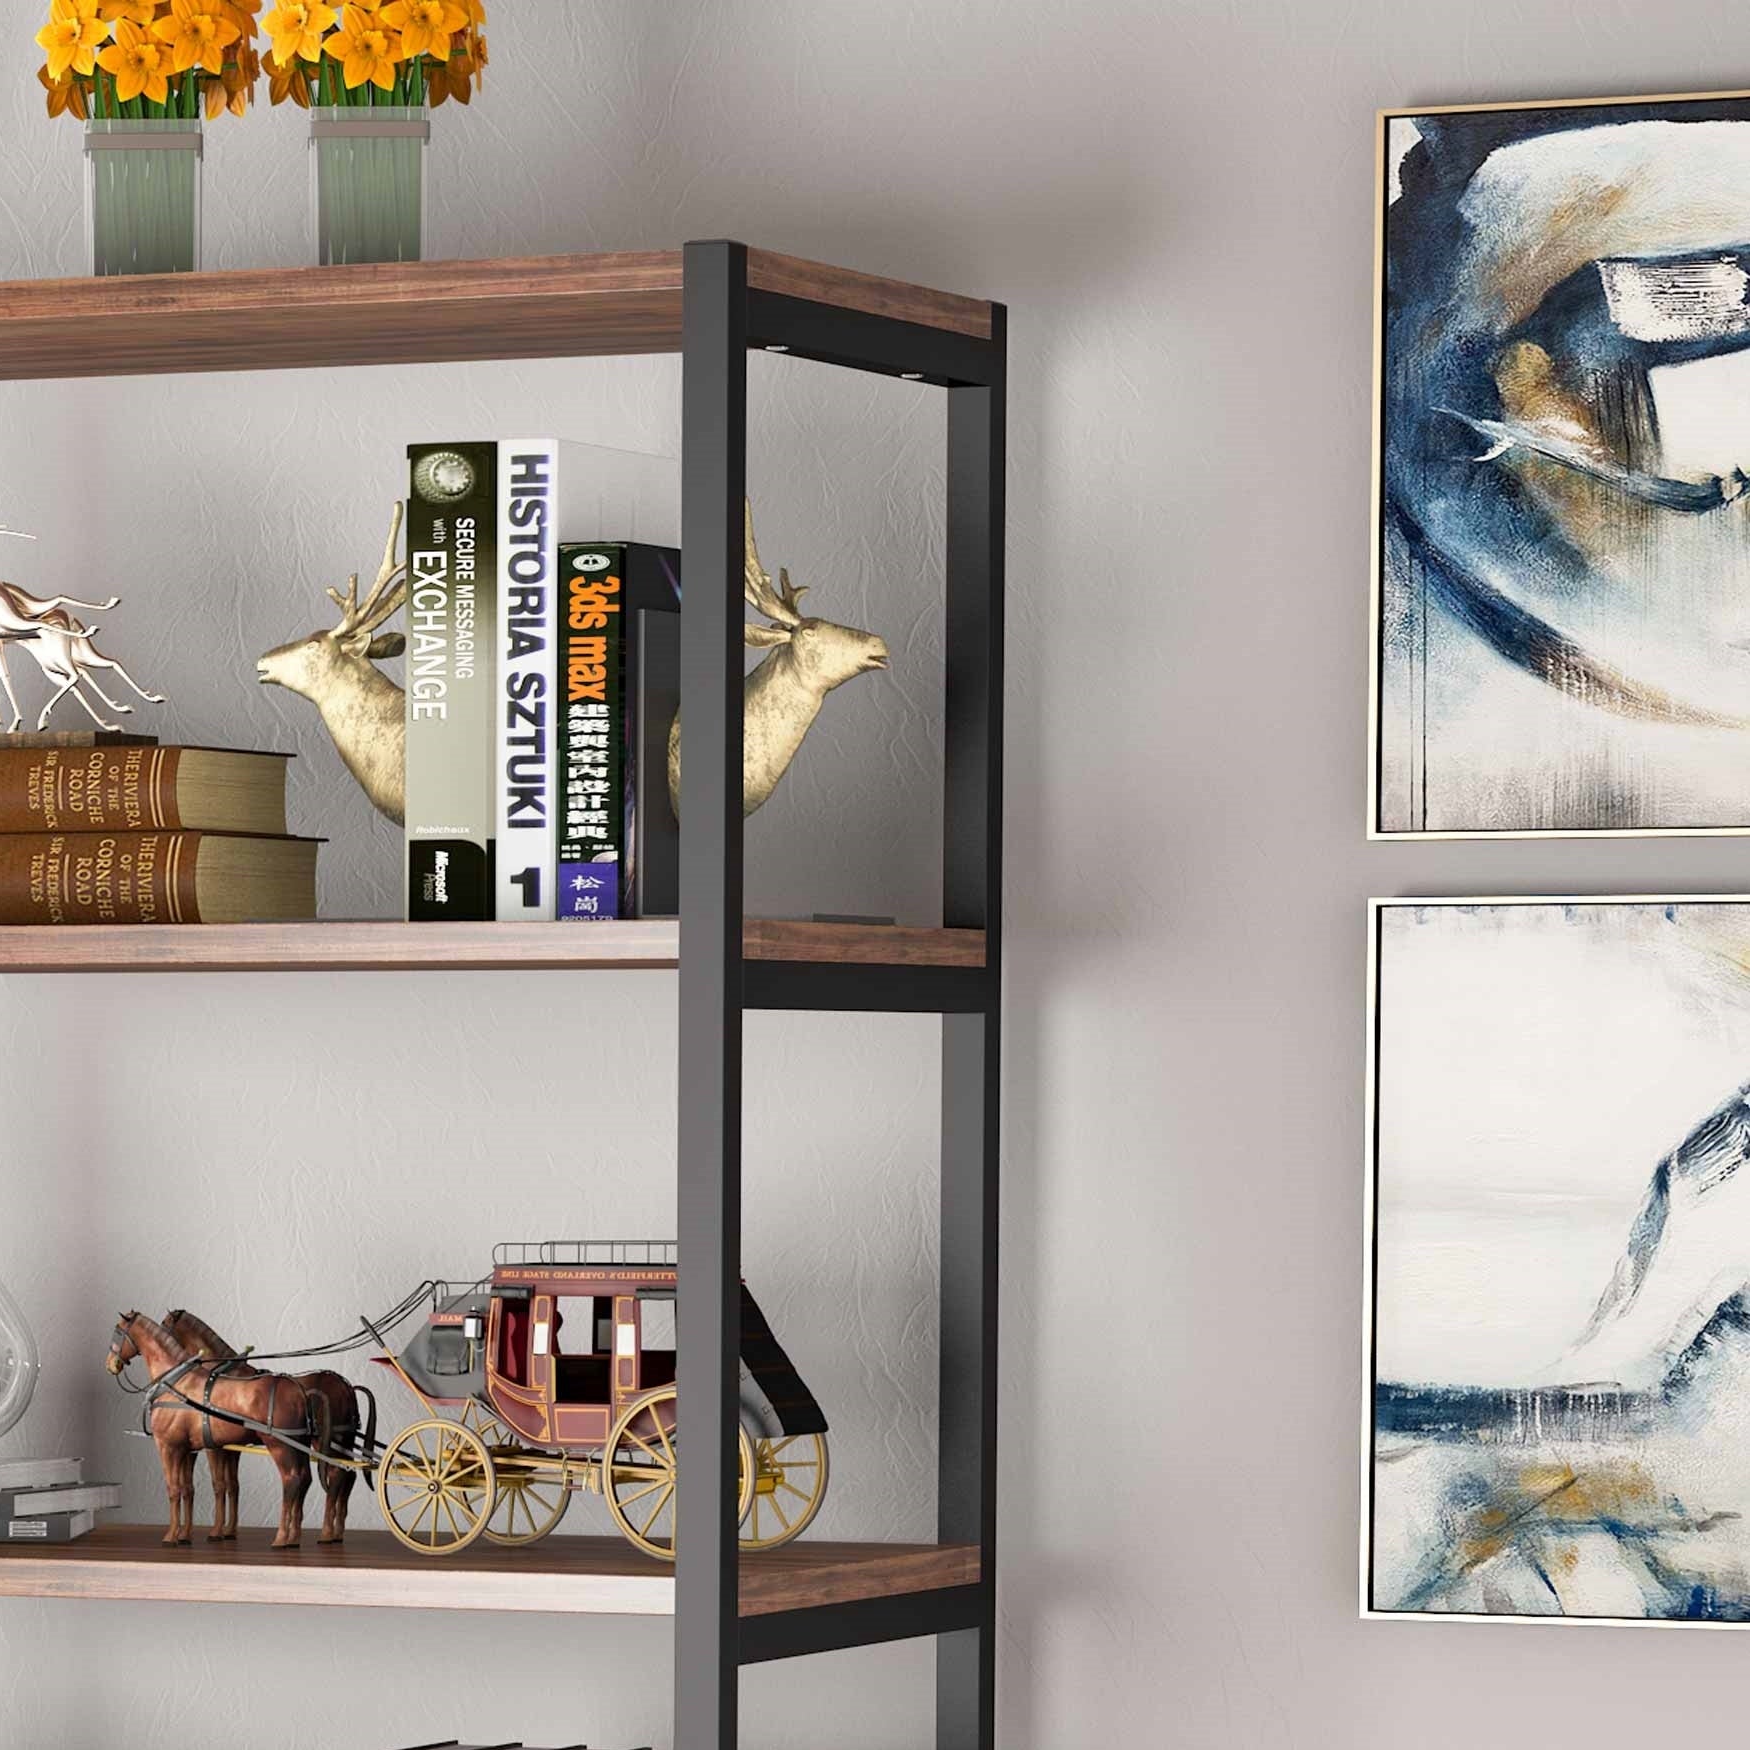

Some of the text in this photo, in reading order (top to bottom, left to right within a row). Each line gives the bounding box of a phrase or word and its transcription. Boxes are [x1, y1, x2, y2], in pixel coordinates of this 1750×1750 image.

[432, 518, 447, 544] with
[455, 517, 475, 679] SECURE MESSAGING
[412, 551, 448, 720] EXCHANGE
[568, 575, 620, 701] 3ds max
[506, 454, 549, 907] HISTORIA SZTUKI 1
[28, 765, 42, 811] TREVES
[42, 750, 59, 829] SIR FREDERICK
[68, 768, 85, 812] ROAD
[86, 751, 105, 824] CORNICHE
[107, 765, 120, 811] OF THE
[30, 852, 45, 903] TREVES
[46, 836, 65, 922] SIR FREDERICK
[75, 857, 93, 905] ROAD
[95, 838, 116, 919] CORNICHE
[119, 854, 132, 904] OF THE
[423, 872, 436, 901] Press
[434, 850, 449, 904] Microsoft
